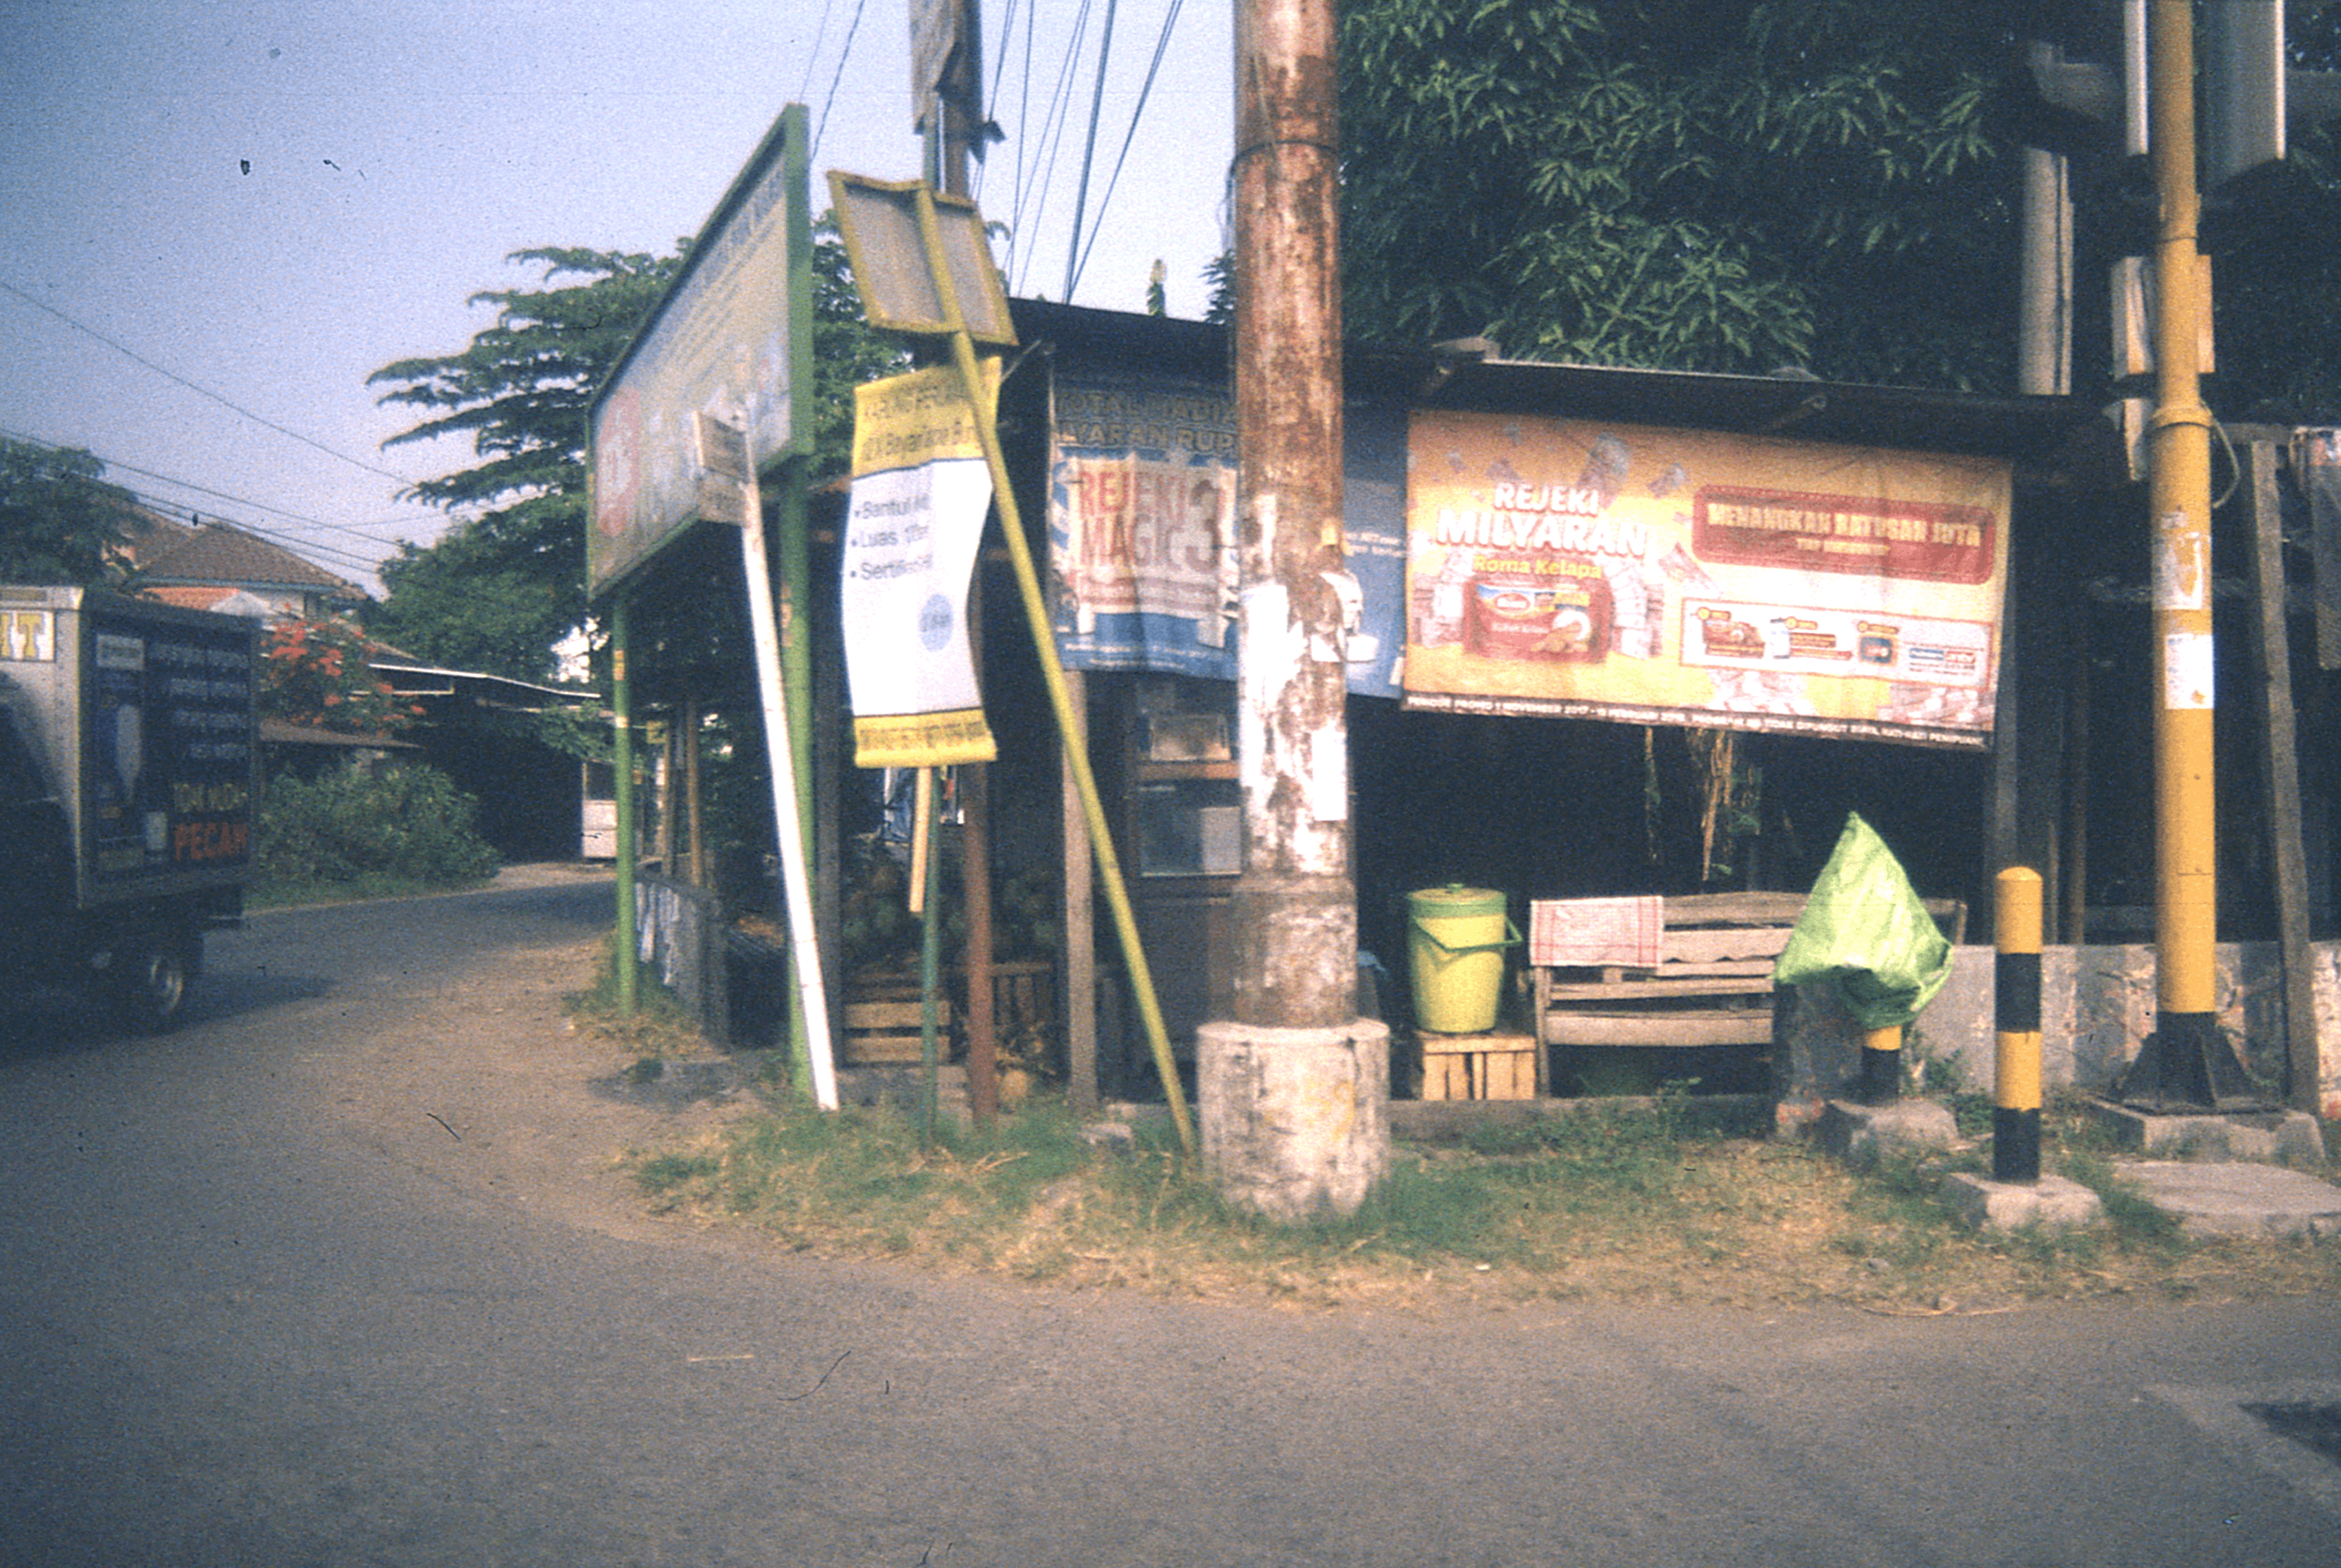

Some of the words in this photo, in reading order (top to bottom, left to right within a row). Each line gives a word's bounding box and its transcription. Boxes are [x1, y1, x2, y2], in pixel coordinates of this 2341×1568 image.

[1494, 483, 1599, 516] REJEKI
[1436, 509, 1646, 557] MILYARAN
[1473, 555, 1530, 573] Roma
[1535, 560, 1602, 579] Kelapa
[1503, 702, 1562, 715] NOVEMBER
